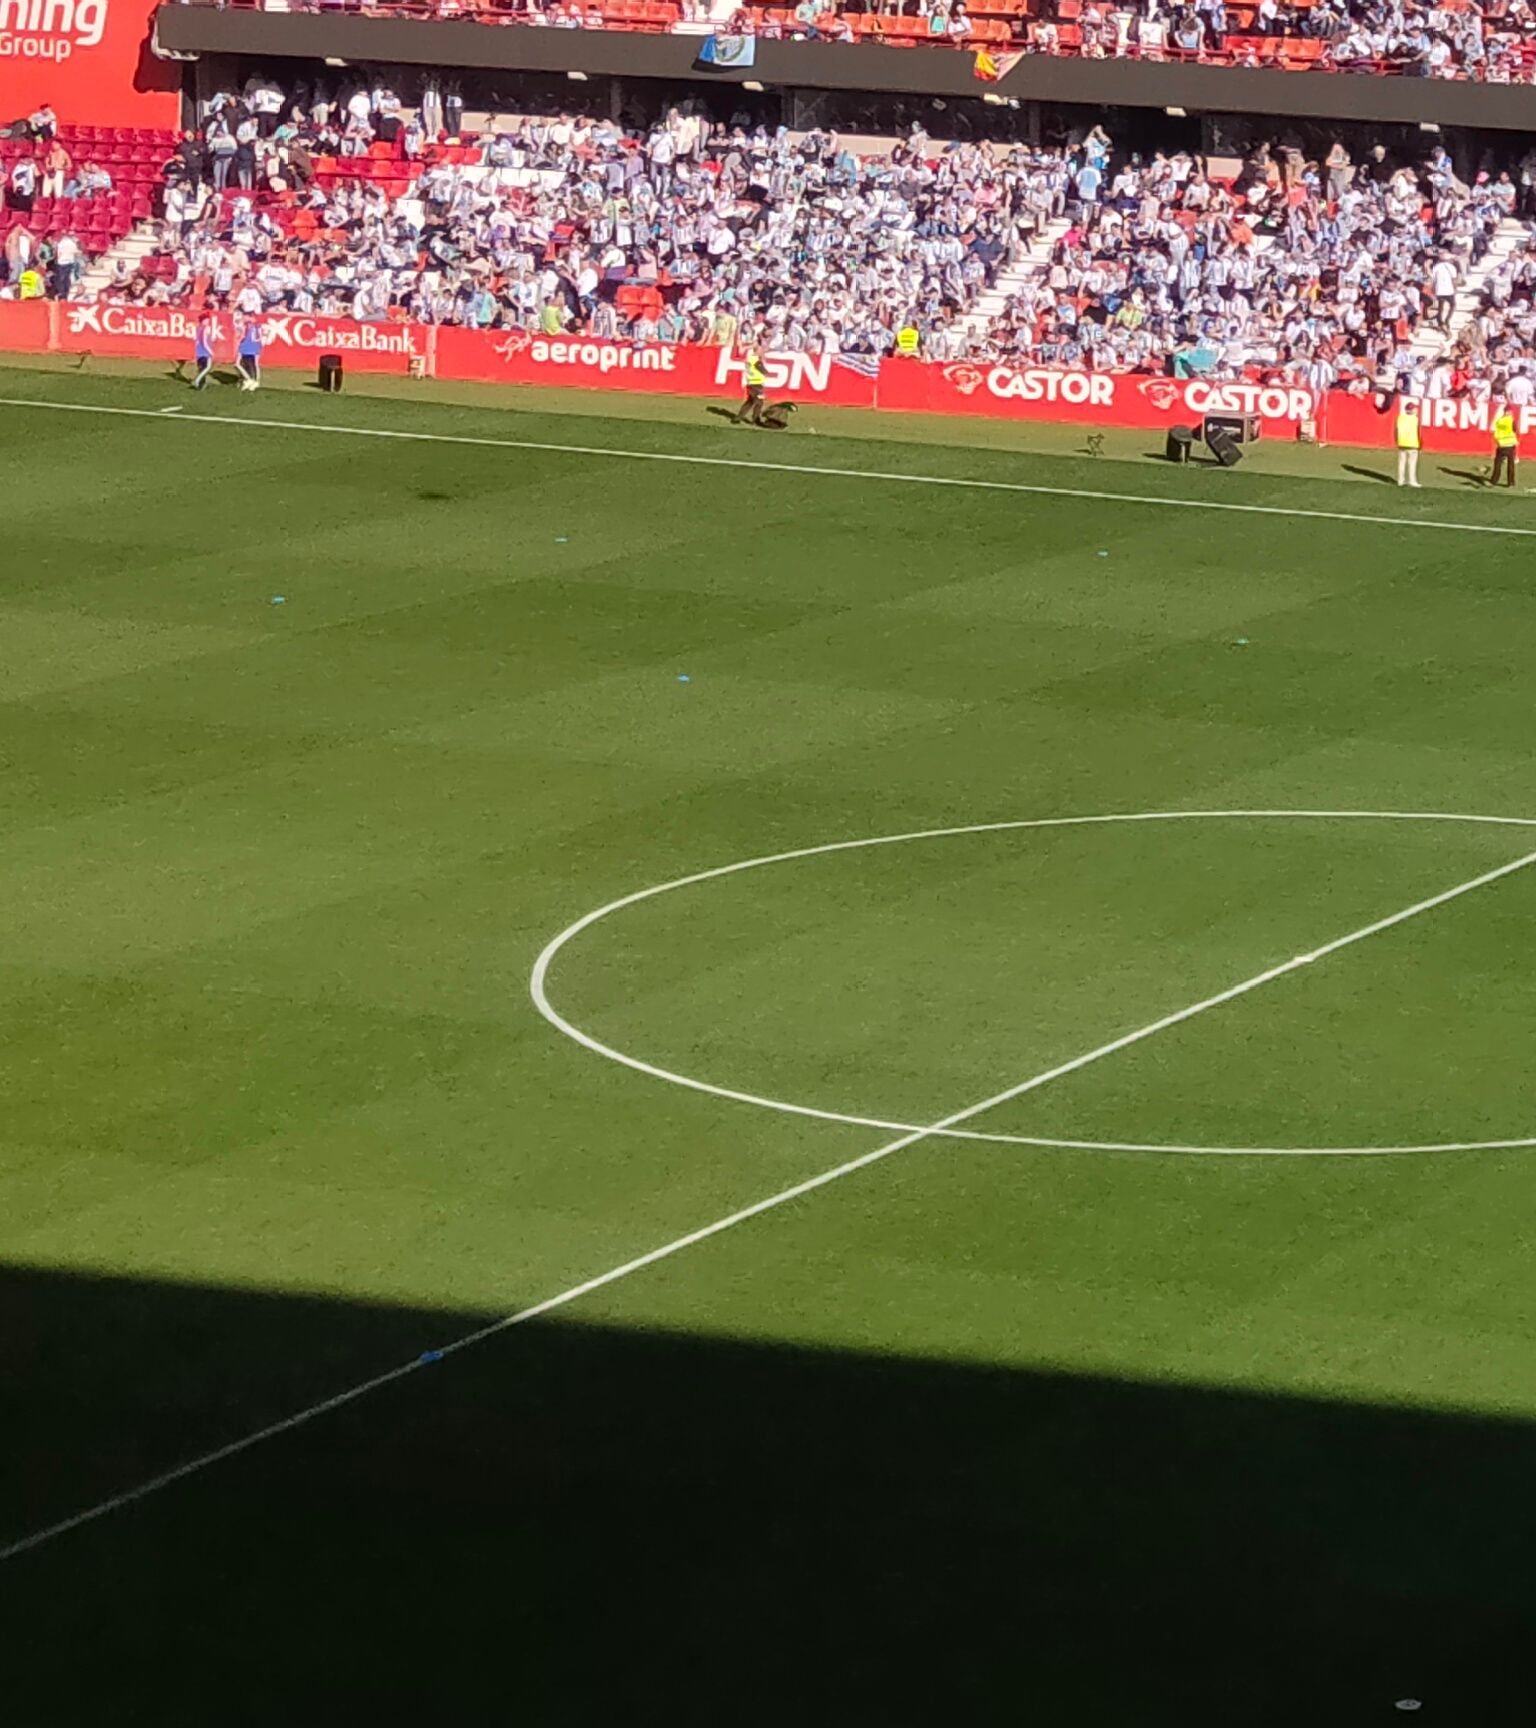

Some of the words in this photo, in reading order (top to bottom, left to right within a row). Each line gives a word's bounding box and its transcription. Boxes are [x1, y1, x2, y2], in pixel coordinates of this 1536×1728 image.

[0, 32, 71, 63] Group
[102, 306, 227, 341] CaixaBak
[293, 320, 417, 354] CaixaBank
[531, 340, 677, 373] aeroprint
[987, 367, 1115, 406] CASTOR
[1184, 381, 1314, 421] CASTOR
